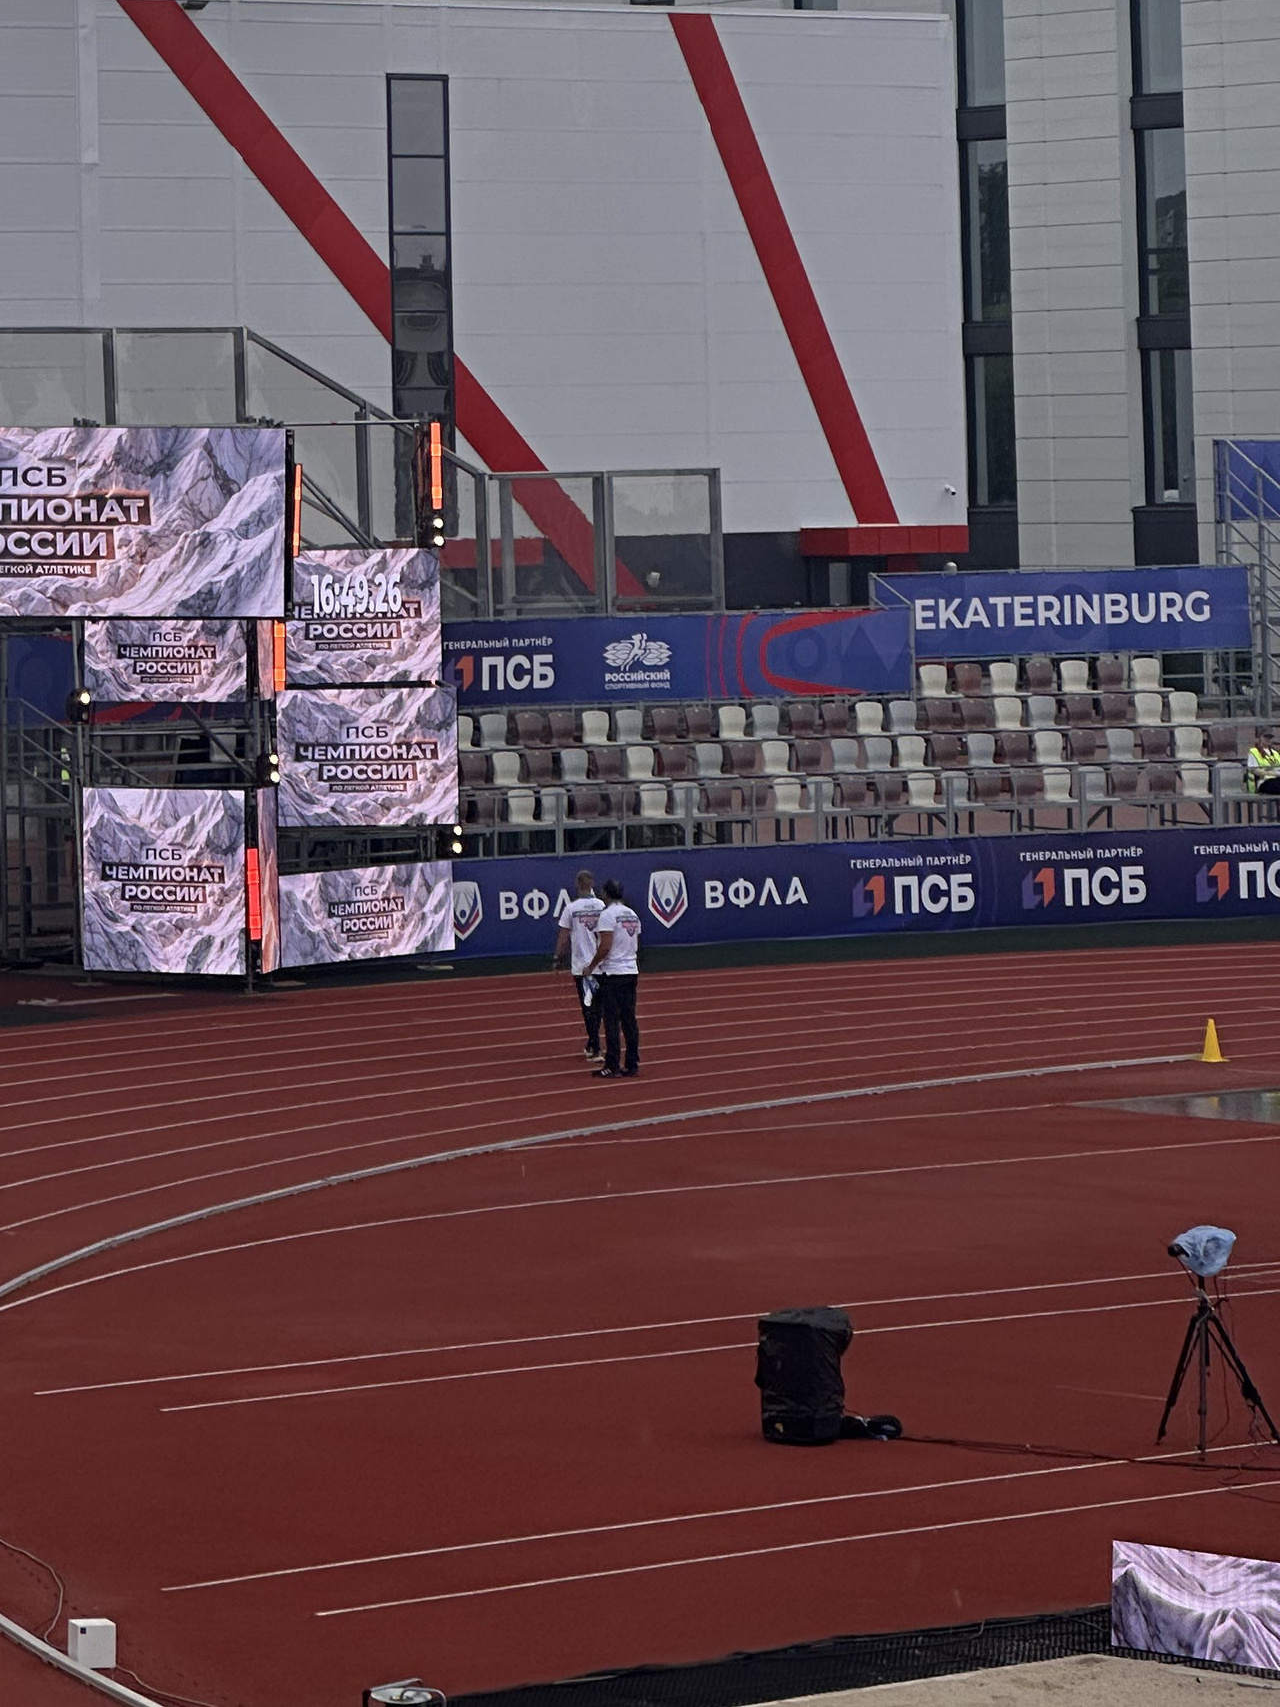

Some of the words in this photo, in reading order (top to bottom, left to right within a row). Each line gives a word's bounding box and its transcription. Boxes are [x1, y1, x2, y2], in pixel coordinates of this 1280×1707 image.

[35, 565, 92, 574] АТЛЕТИКЕ
[310, 573, 402, 614] 16:49.26
[914, 591, 1211, 630] EKATERINBURG
[153, 632, 182, 642] ПСБ
[309, 622, 398, 639] РОССИИ
[443, 637, 509, 650] ГЕНЕРАЛЬНЫЙ
[512, 636, 553, 647] ПАРТНЁР
[120, 646, 215, 659] ЧЕМПИОНАТ
[136, 662, 199, 674] РОССИИ
[481, 654, 555, 691] ПСБ
[605, 669, 670, 682] РОССИЙСКИЙ
[346, 726, 389, 738] ПСБ
[299, 744, 435, 760] ЧЕМПИОНАТ
[323, 765, 413, 780] РОССИИ
[145, 848, 182, 860] ПСБ
[1020, 847, 1094, 861] ГЕНЕРАЛЬНЫЙ
[1097, 846, 1143, 857] ПАРТНЁР
[1194, 841, 1269, 855] ГЕНЕРАЛЬНЫЙ
[850, 855, 923, 869] ГЕНЕРАЛЬНЫЙ
[926, 854, 971, 865] ПАРТНЁР
[105, 865, 222, 882] ЧЕМПИОНАТ
[124, 885, 203, 902] РОССИИ
[355, 886, 378, 897] ПСБ
[705, 876, 808, 909] ВФЛА
[1063, 865, 1147, 907] ПСБ
[894, 874, 975, 914] ПСБ
[330, 898, 403, 915] ЧЕМПИОНАТ
[342, 916, 392, 932] РОССИИ
